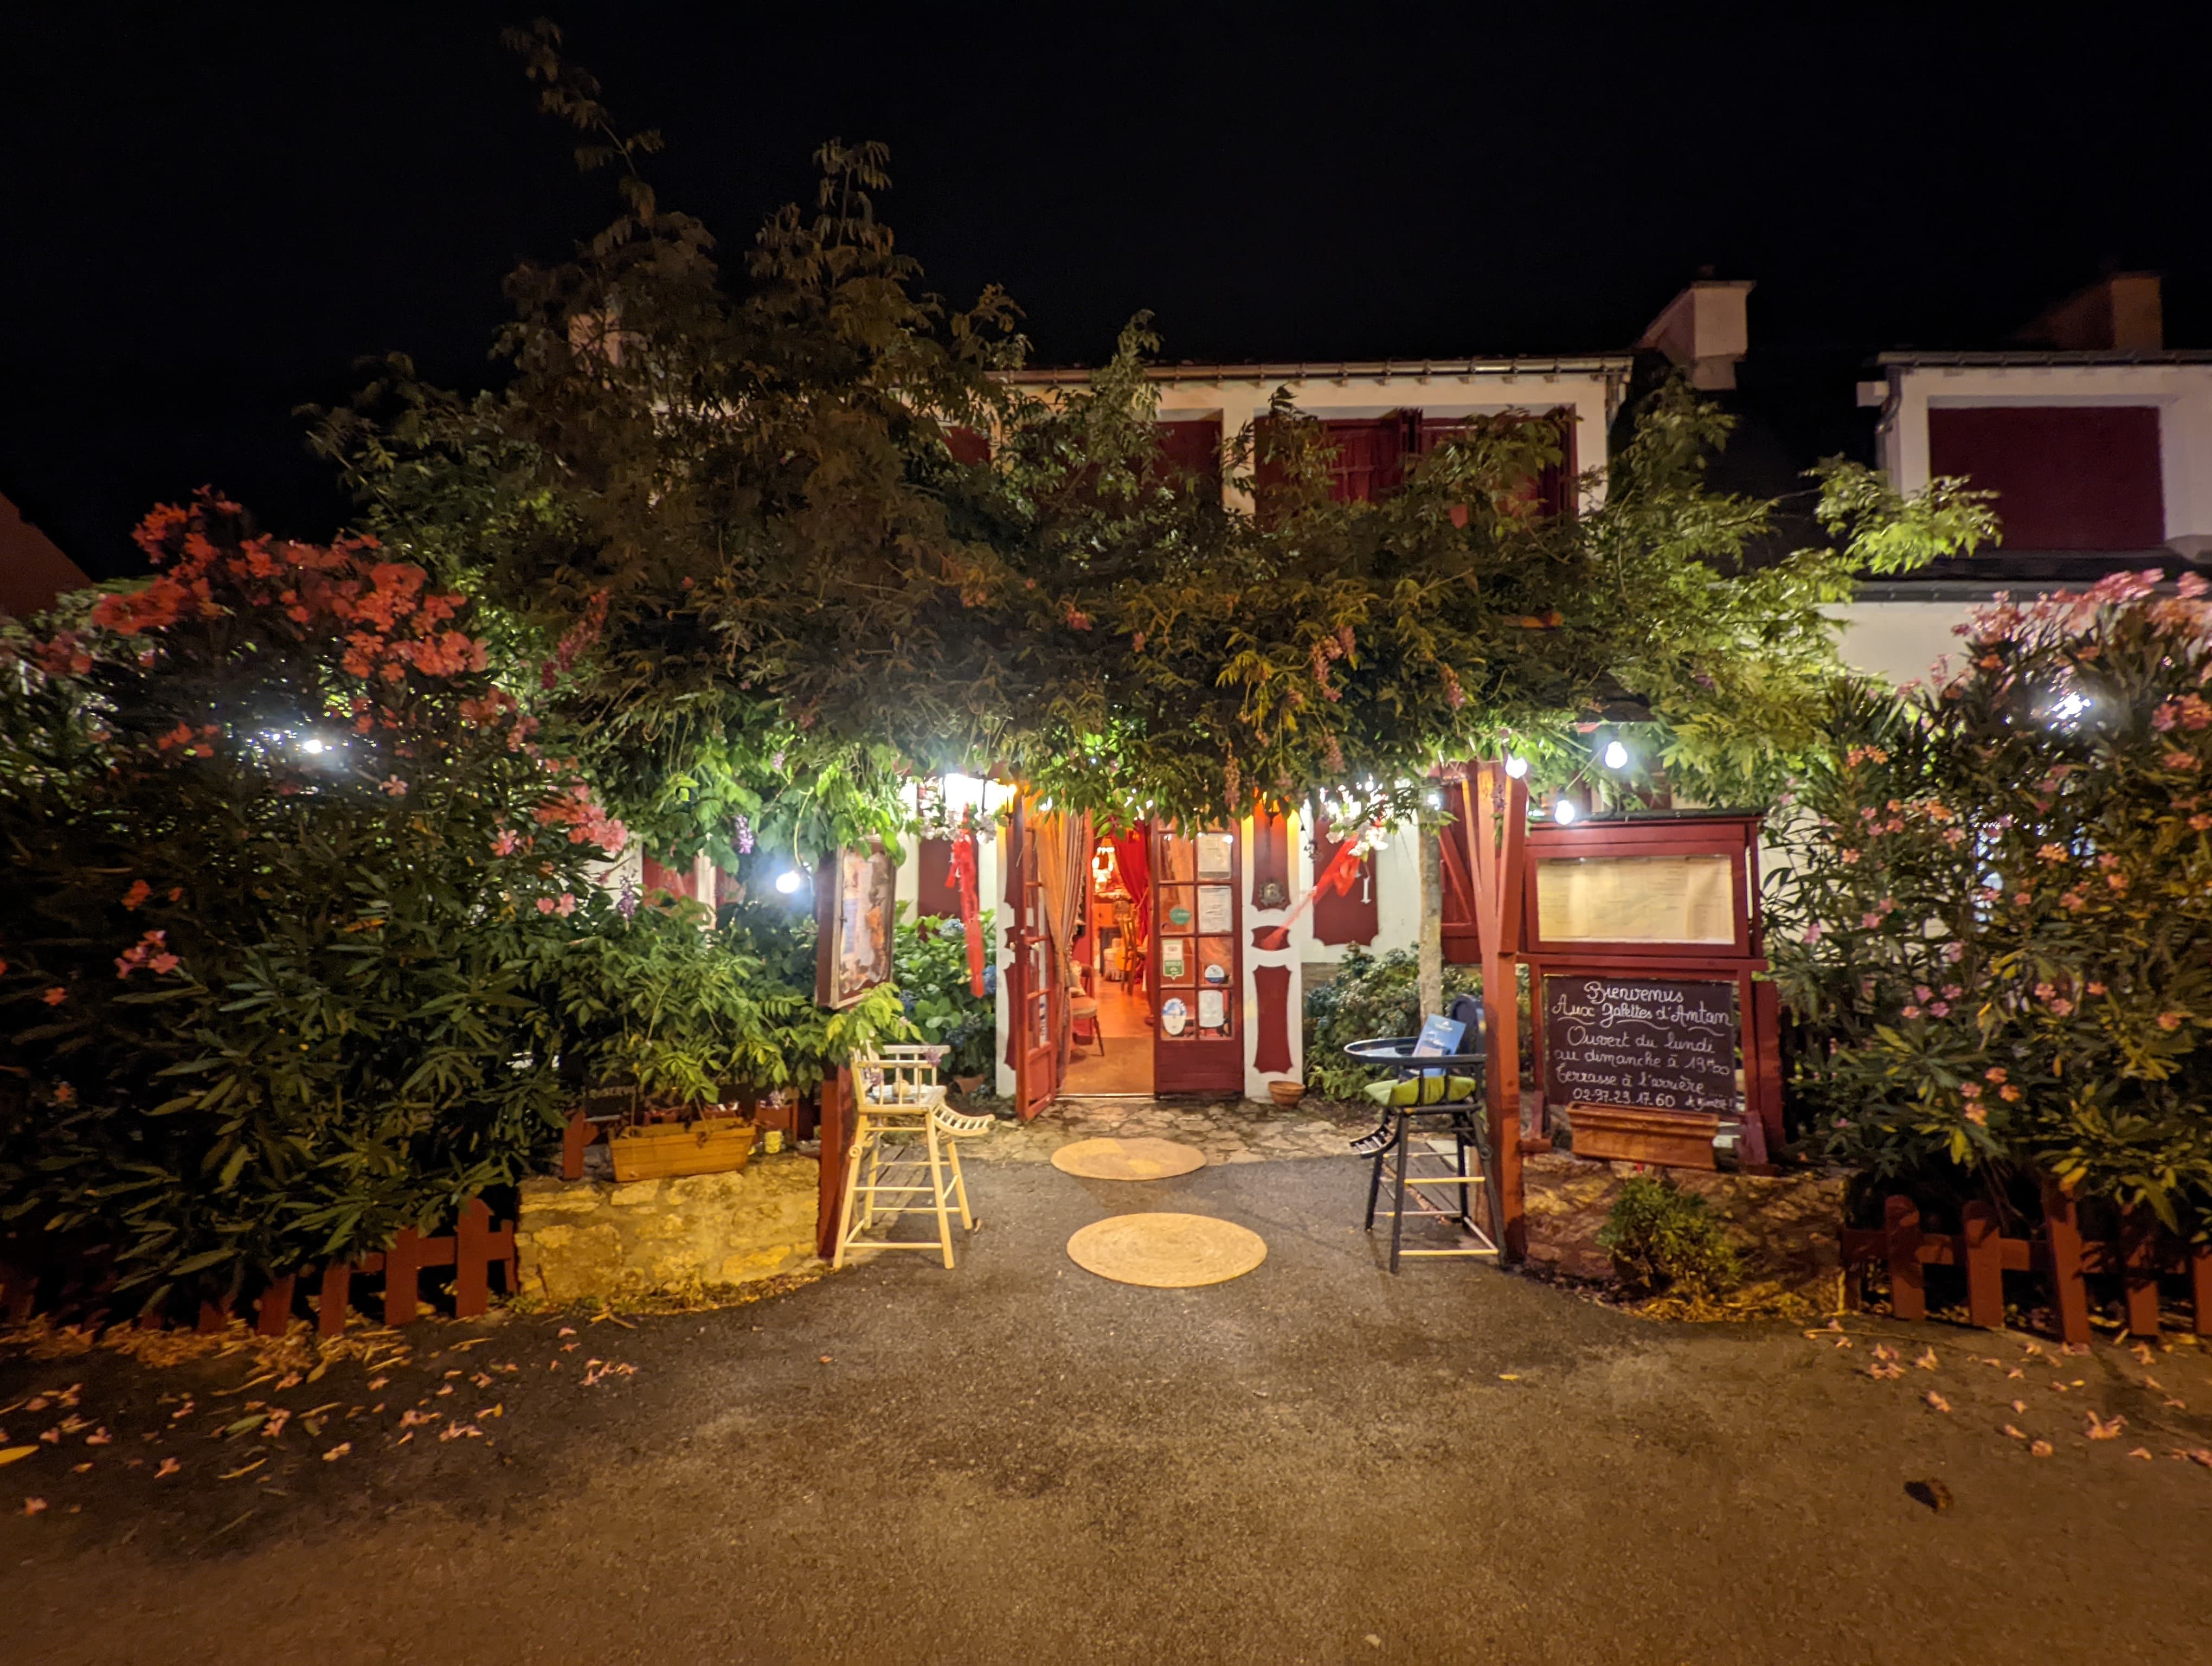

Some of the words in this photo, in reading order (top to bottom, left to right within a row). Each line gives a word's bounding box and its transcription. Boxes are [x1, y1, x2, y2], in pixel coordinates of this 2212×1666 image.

[1584, 981, 1684, 1004] Bienvenus
[1552, 994, 1596, 1016] Aux
[1567, 1026, 1630, 1047] Ouvert
[1635, 1034, 1657, 1048] du
[1663, 1031, 1715, 1053] lundi
[1554, 1049, 1580, 1061] au
[1584, 1048, 1661, 1067] dimanche
[1621, 1074, 1632, 1088] à
[1638, 1071, 1706, 1095] l'arrière
